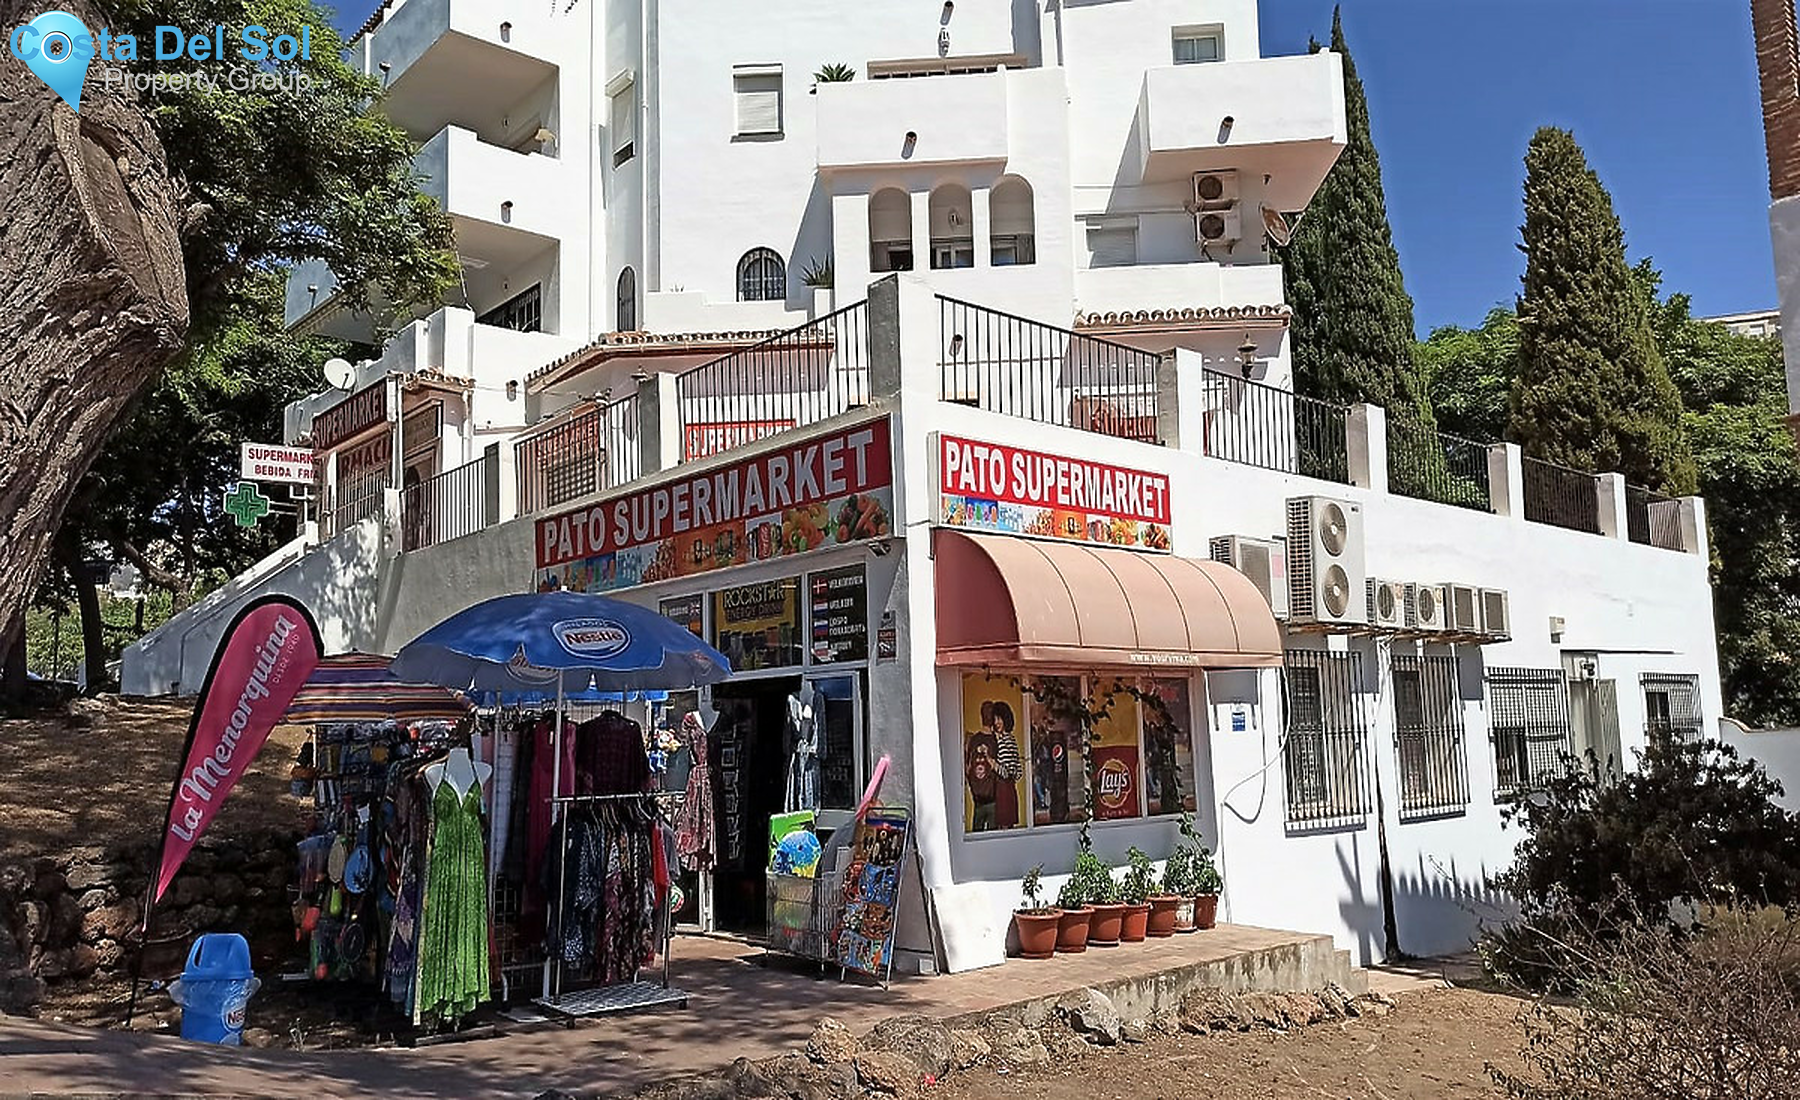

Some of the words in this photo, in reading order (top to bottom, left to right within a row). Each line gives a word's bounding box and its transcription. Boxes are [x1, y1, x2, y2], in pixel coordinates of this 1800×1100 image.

[313, 383, 385, 450] SUPERMARKET
[254, 464, 291, 477] BEBIDA
[544, 507, 607, 564] PATO
[613, 429, 874, 545] SUPERMARKET
[946, 440, 1006, 496] PATO
[1012, 452, 1166, 519] SUPERMARKET
[179, 614, 297, 802] Menorquina
